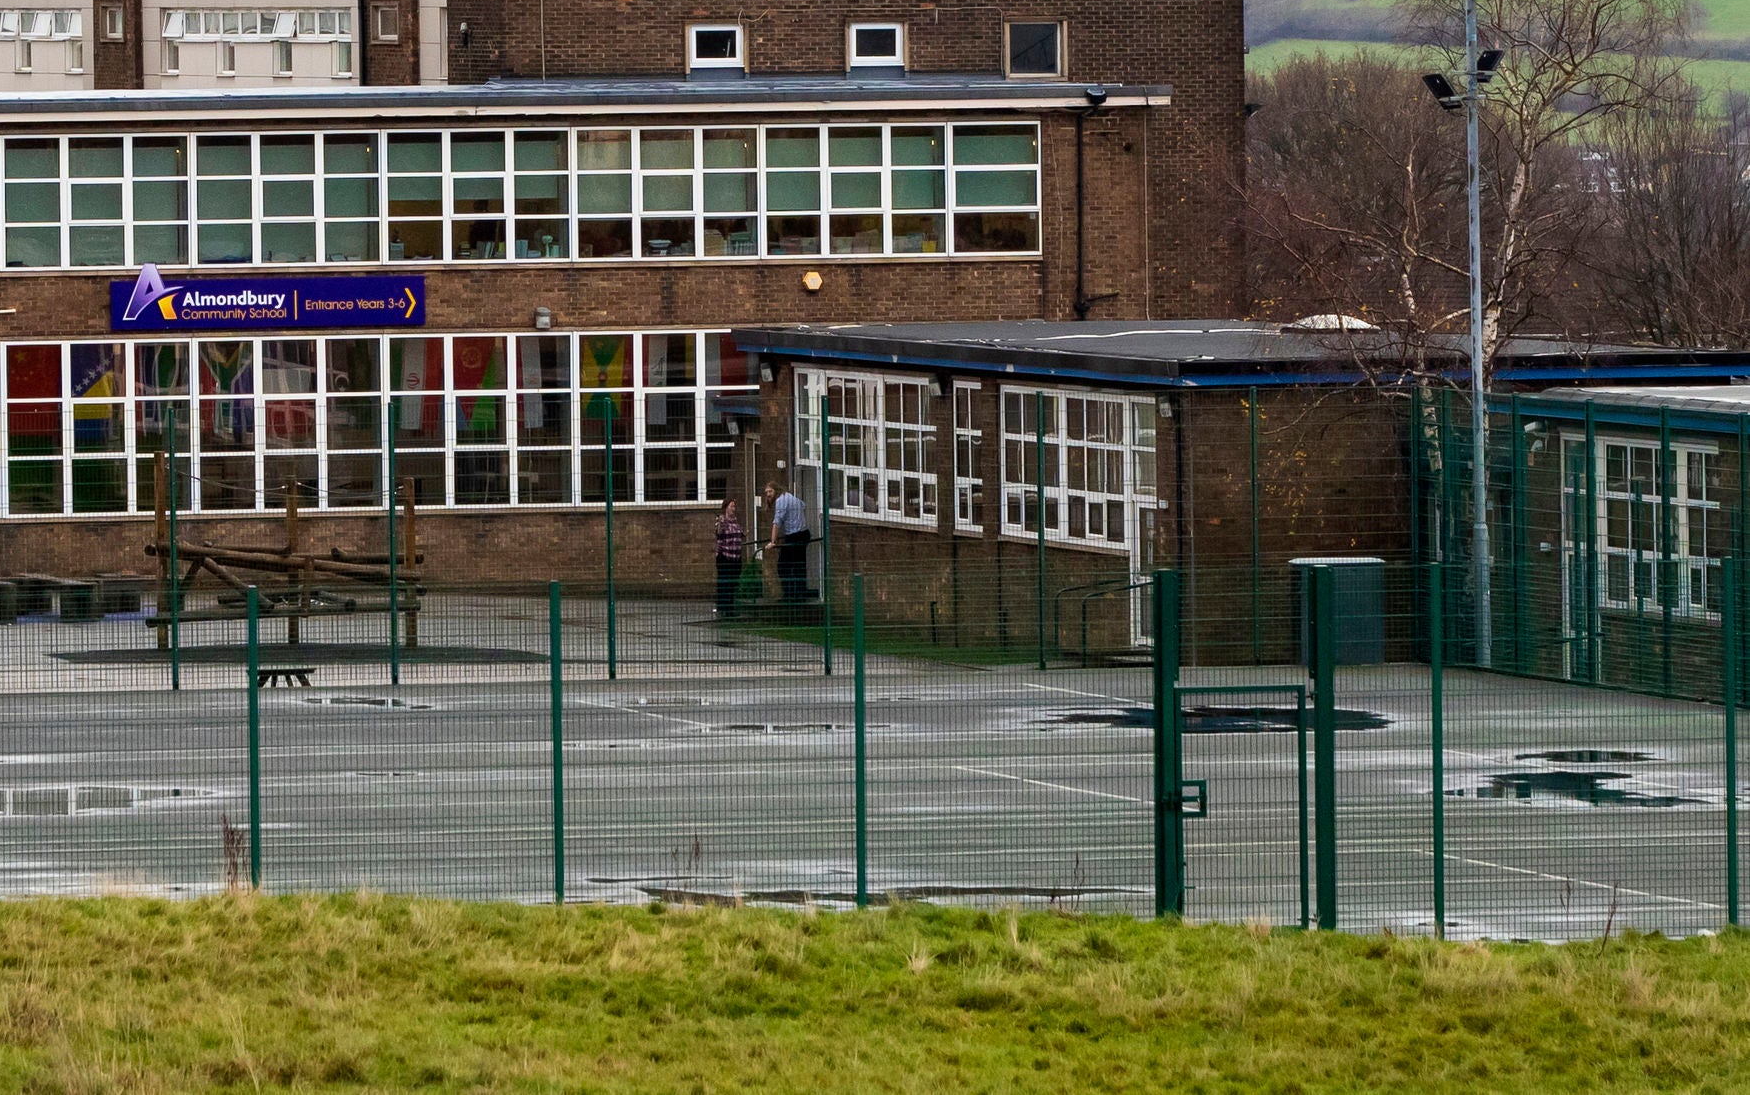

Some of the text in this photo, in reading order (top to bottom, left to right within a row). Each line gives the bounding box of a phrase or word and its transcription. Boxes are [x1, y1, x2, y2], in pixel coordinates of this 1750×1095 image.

[182, 290, 286, 309] Almondbury
[305, 297, 406, 311] Entrance Years 3-6
[181, 307, 287, 321] Community School
